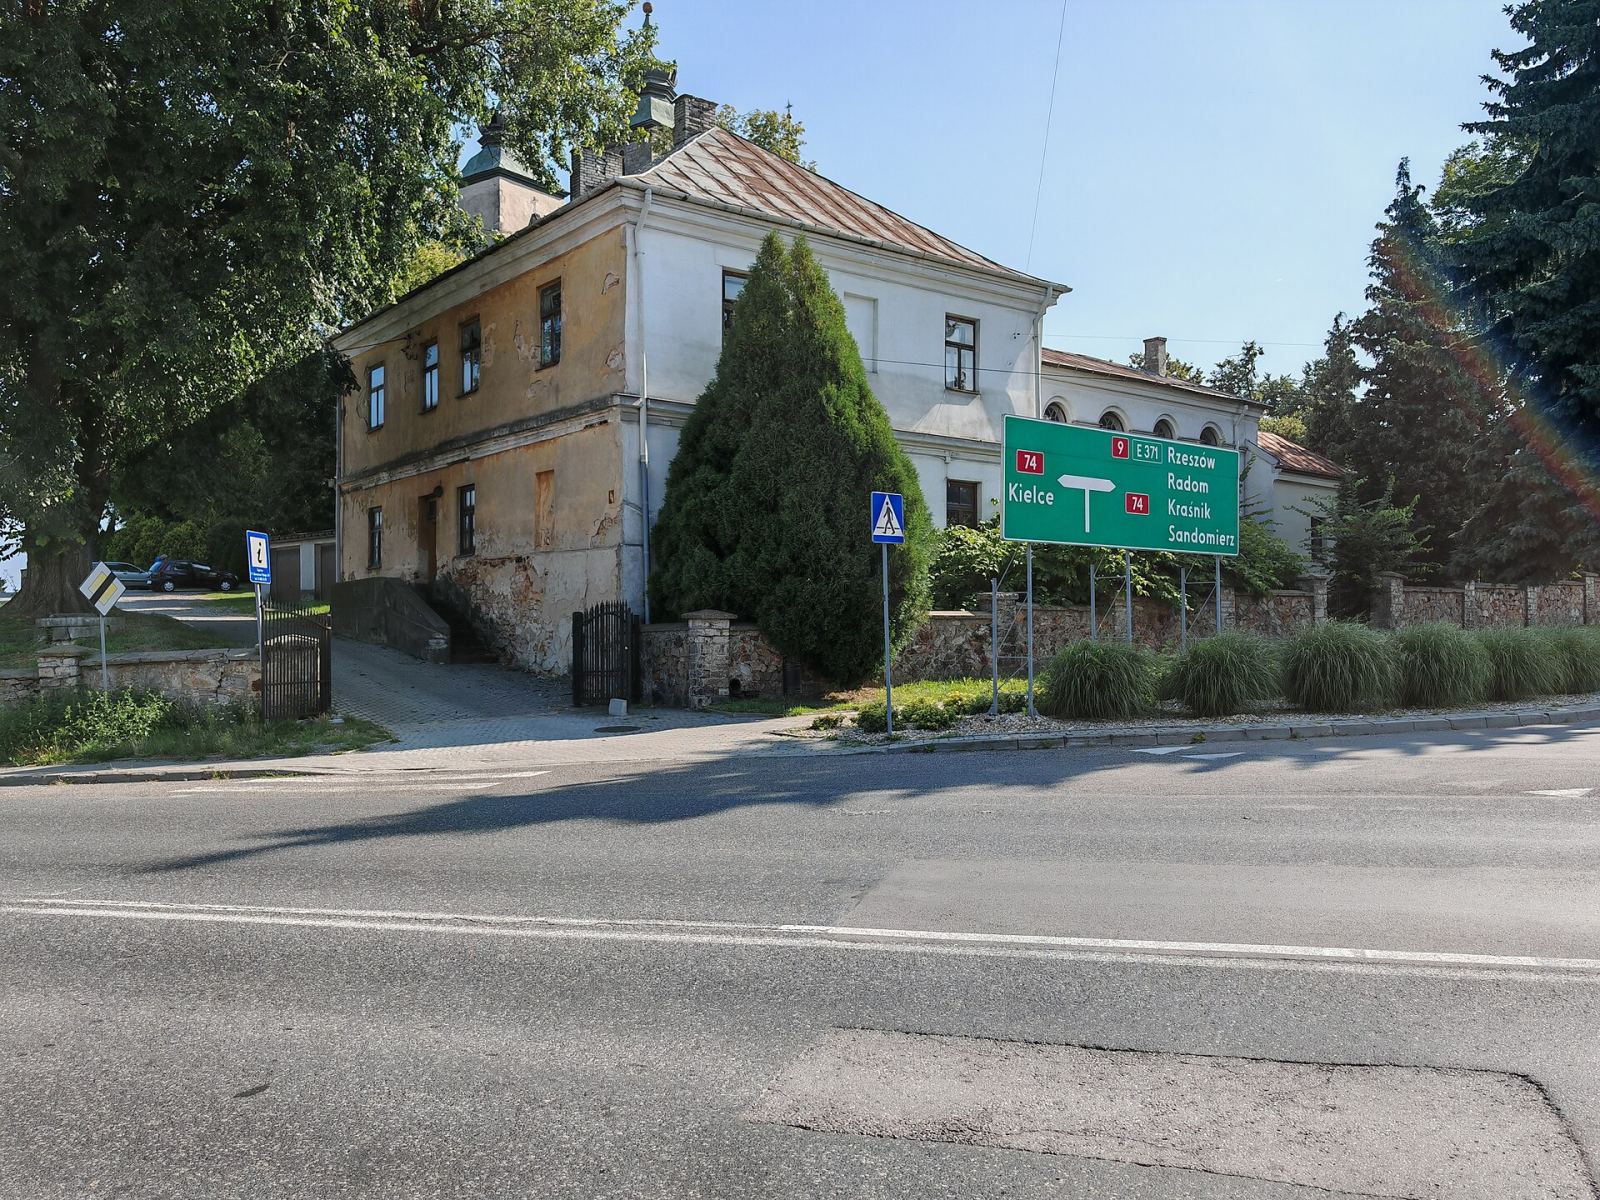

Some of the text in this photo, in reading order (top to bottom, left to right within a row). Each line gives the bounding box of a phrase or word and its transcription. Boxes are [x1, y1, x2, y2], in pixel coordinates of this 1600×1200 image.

[1117, 441, 1124, 455] 9
[1167, 446, 1215, 469] Rzeszów
[1023, 454, 1037, 471] 74
[1168, 472, 1209, 493] Radom
[1008, 482, 1054, 505] Kielce
[1131, 496, 1143, 512] 74
[1168, 498, 1211, 520] Kraśnik
[1168, 525, 1235, 547] Sandomierz
